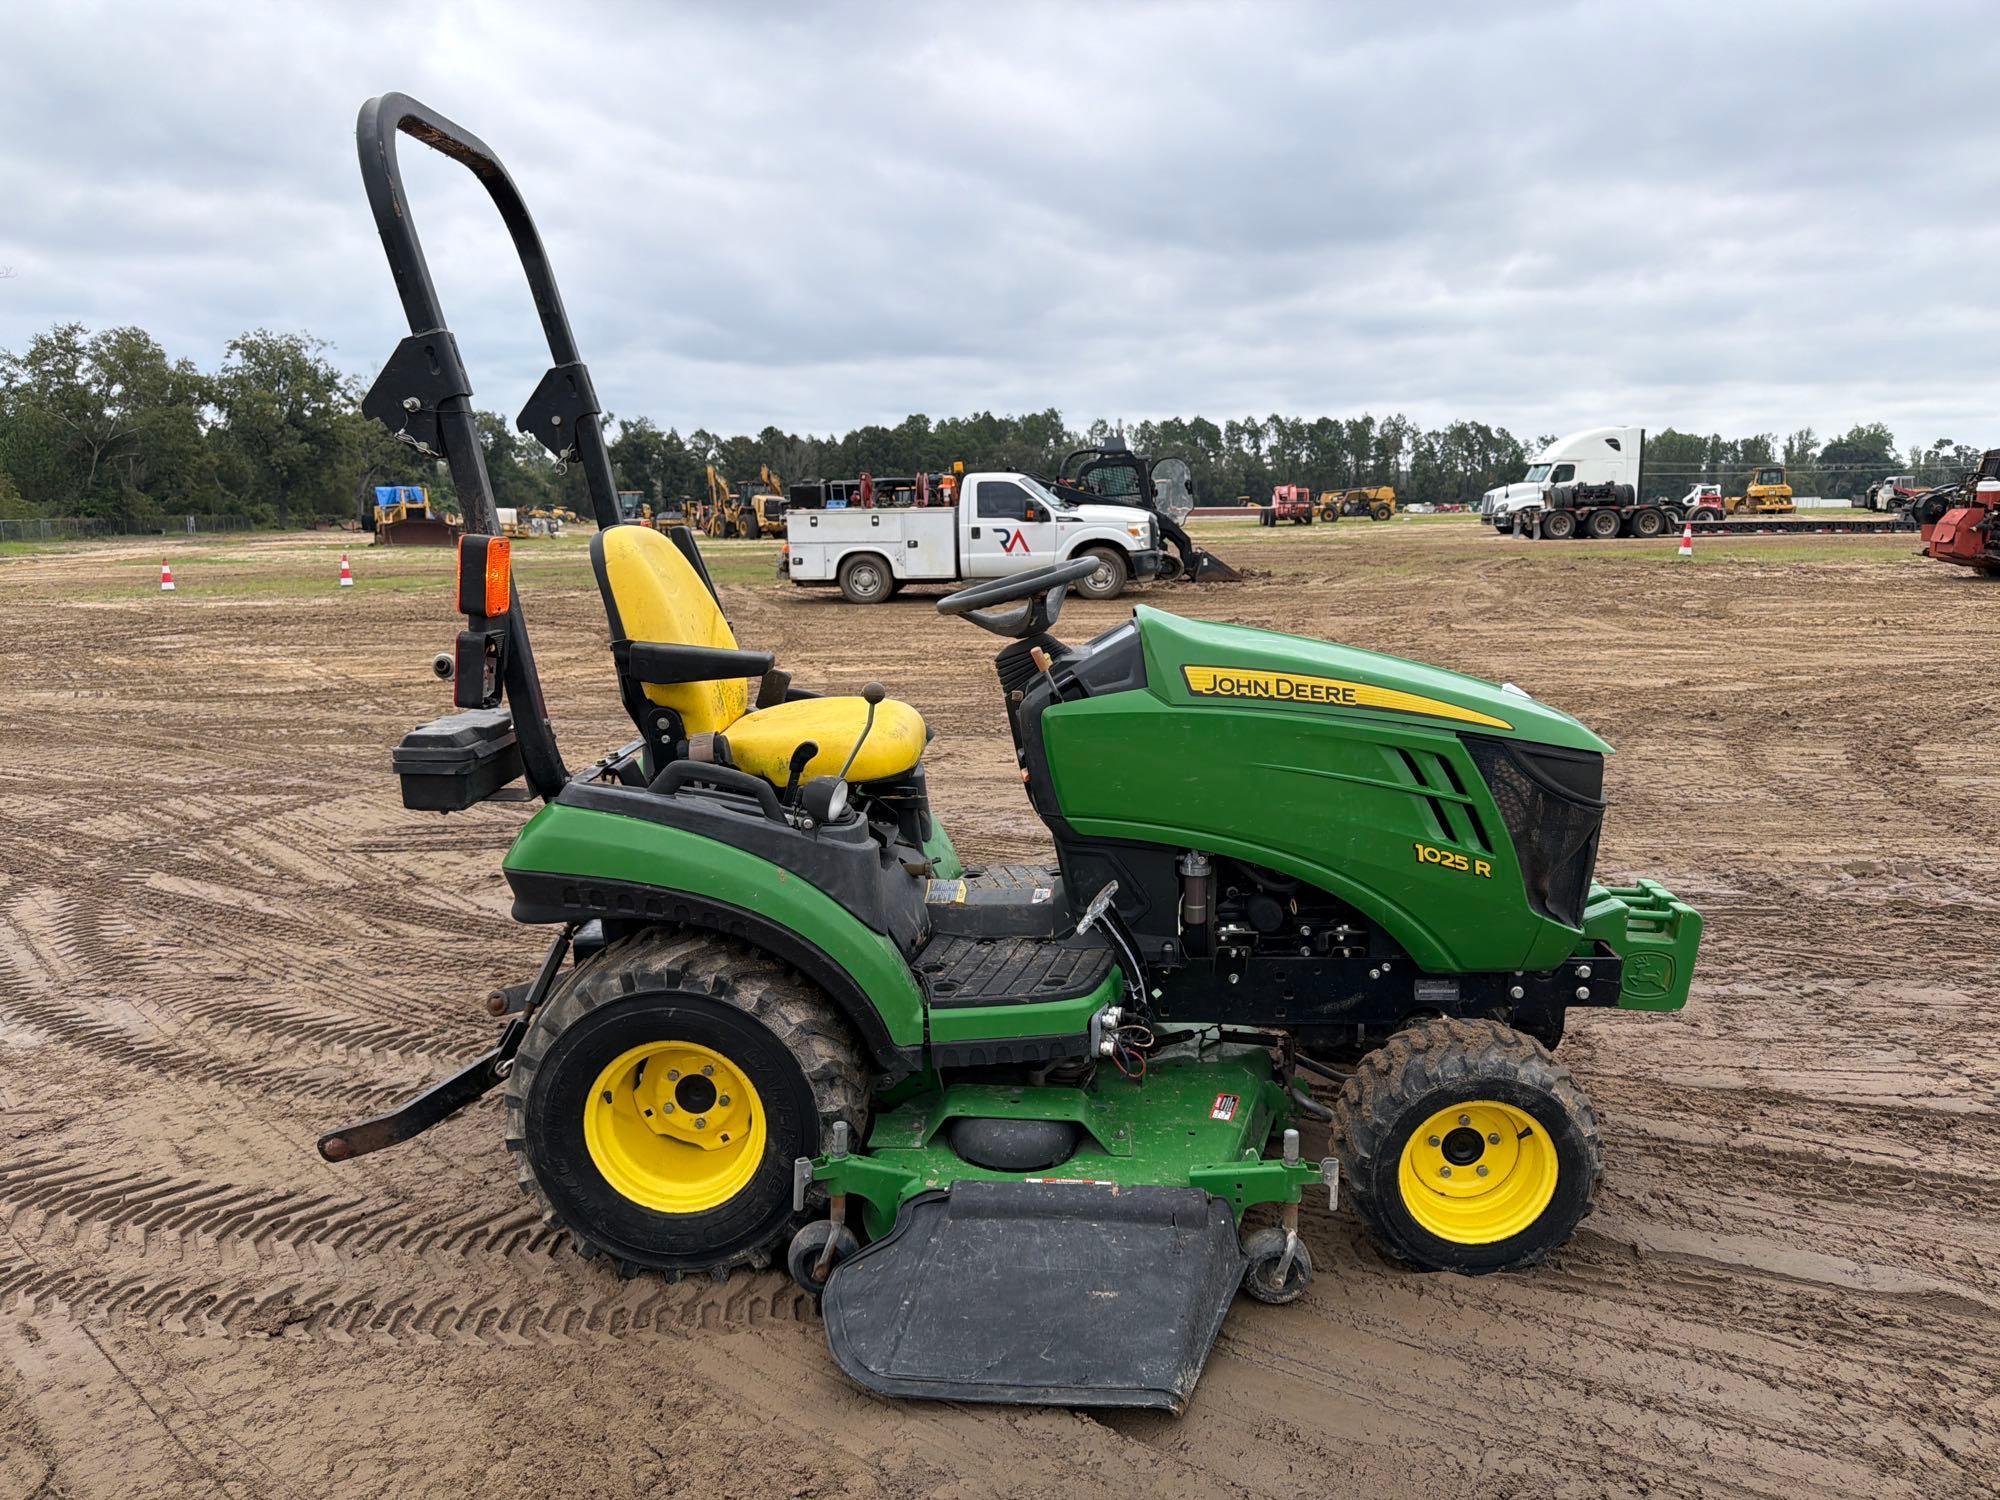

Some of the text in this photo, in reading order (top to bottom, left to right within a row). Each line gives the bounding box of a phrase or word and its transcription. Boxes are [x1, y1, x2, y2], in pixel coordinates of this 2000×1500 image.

[1203, 674, 1357, 704] JOHN DEERE
[1414, 843, 1492, 878] 1025 R
